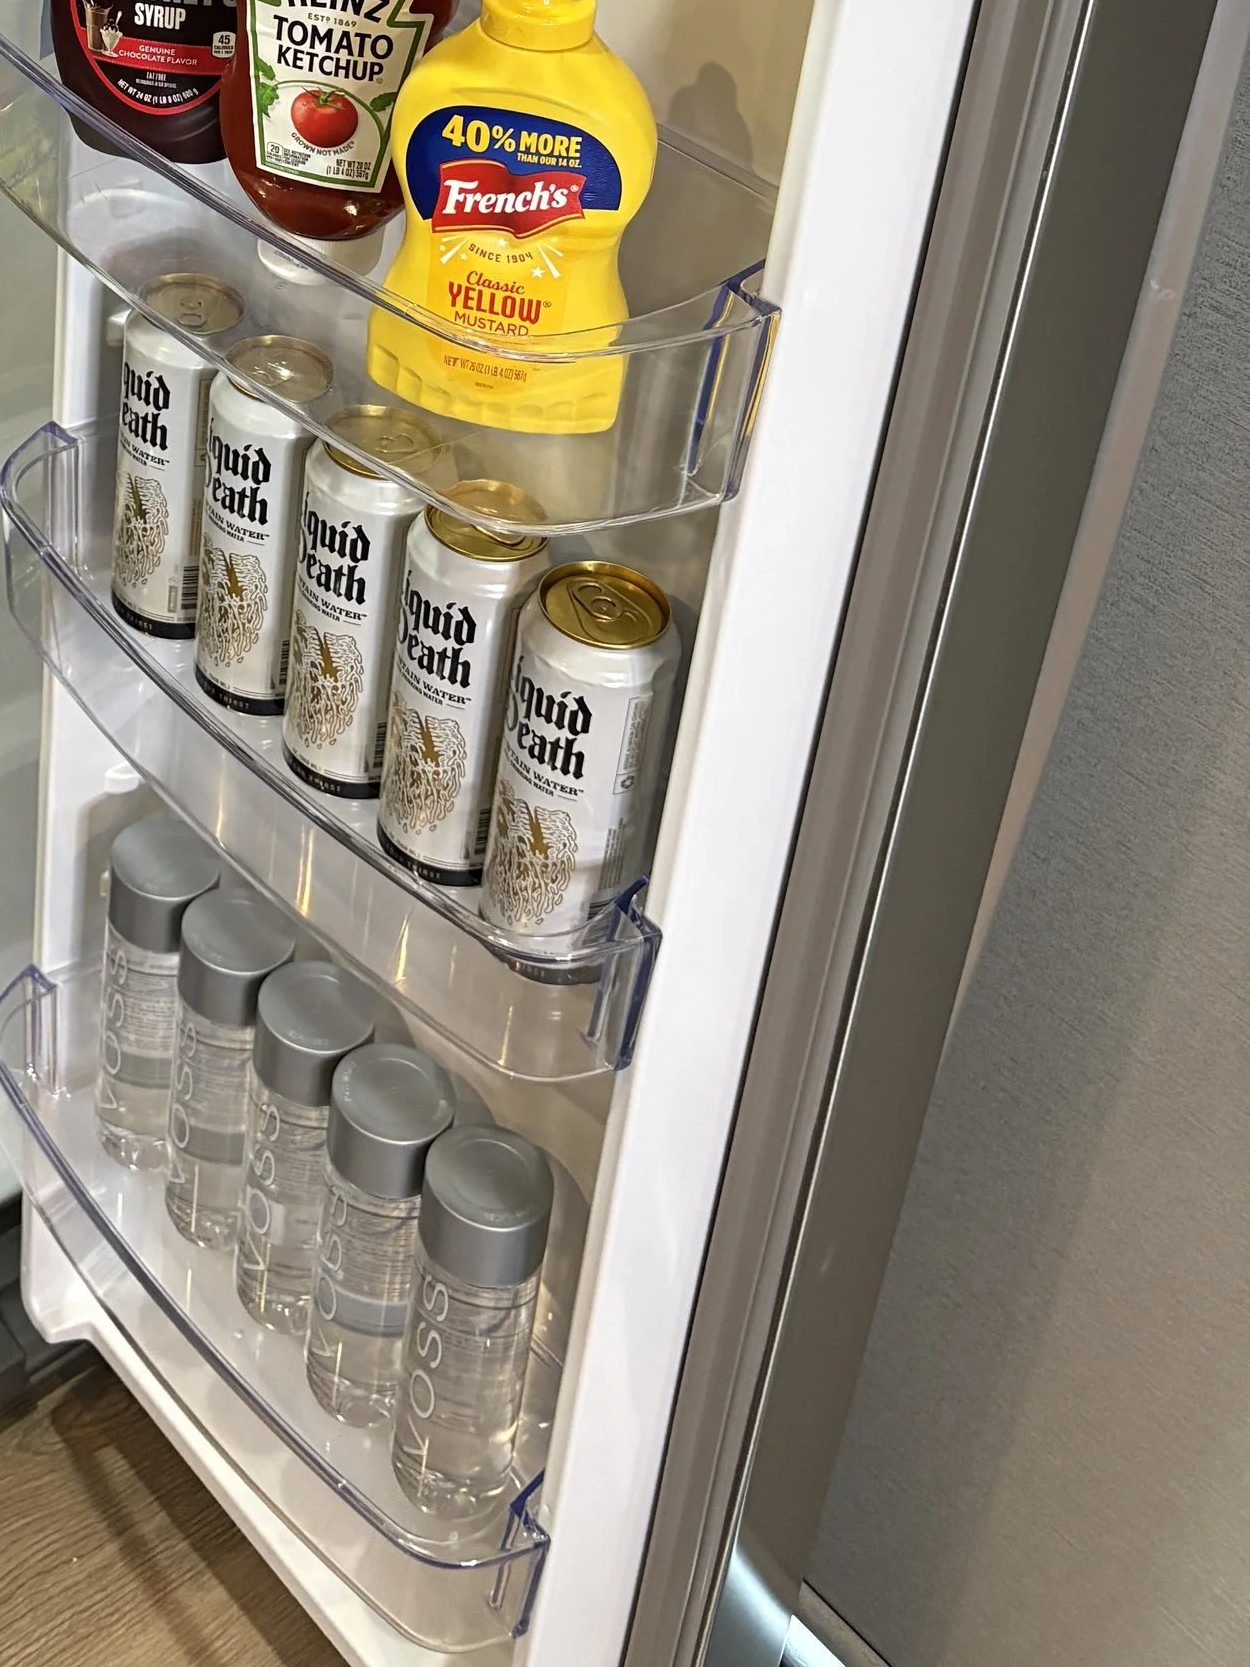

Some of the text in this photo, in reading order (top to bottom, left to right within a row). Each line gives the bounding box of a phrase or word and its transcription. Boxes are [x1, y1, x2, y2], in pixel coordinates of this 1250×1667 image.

[134, 2, 187, 30] SYRUP
[333, 17, 358, 28] 1869
[218, 35, 231, 45] 45
[273, 14, 394, 60] TOMATO
[118, 49, 198, 66] CHOCOLATE FLAVOR
[138, 44, 176, 56] GENUINE
[277, 44, 384, 82] KETCHUP
[117, 78, 128, 91] NET
[291, 132, 331, 157] GROWN NOT
[441, 114, 583, 158] 40% MORE
[336, 158, 346, 167] NET
[517, 152, 582, 168] THAN OUR 14 OZ.
[468, 242, 534, 264] SINCE 1904
[466, 270, 526, 295] Classic
[448, 280, 542, 325] YELLOW
[454, 310, 529, 337] MUSTARD
[443, 355, 460, 367] NET
[124, 361, 171, 412] quid
[122, 403, 169, 451] eath
[132, 444, 165, 466] WATER
[206, 418, 272, 486] iquid
[226, 519, 264, 541] WATER
[303, 492, 371, 564] iquid
[320, 598, 361, 621] WATER
[404, 569, 477, 647] iquid
[422, 680, 466, 705] WATER
[515, 655, 593, 736] iquid
[531, 781, 554, 797] WATER
[532, 771, 579, 796] WATER
[403, 1273, 449, 1457] VOSS
